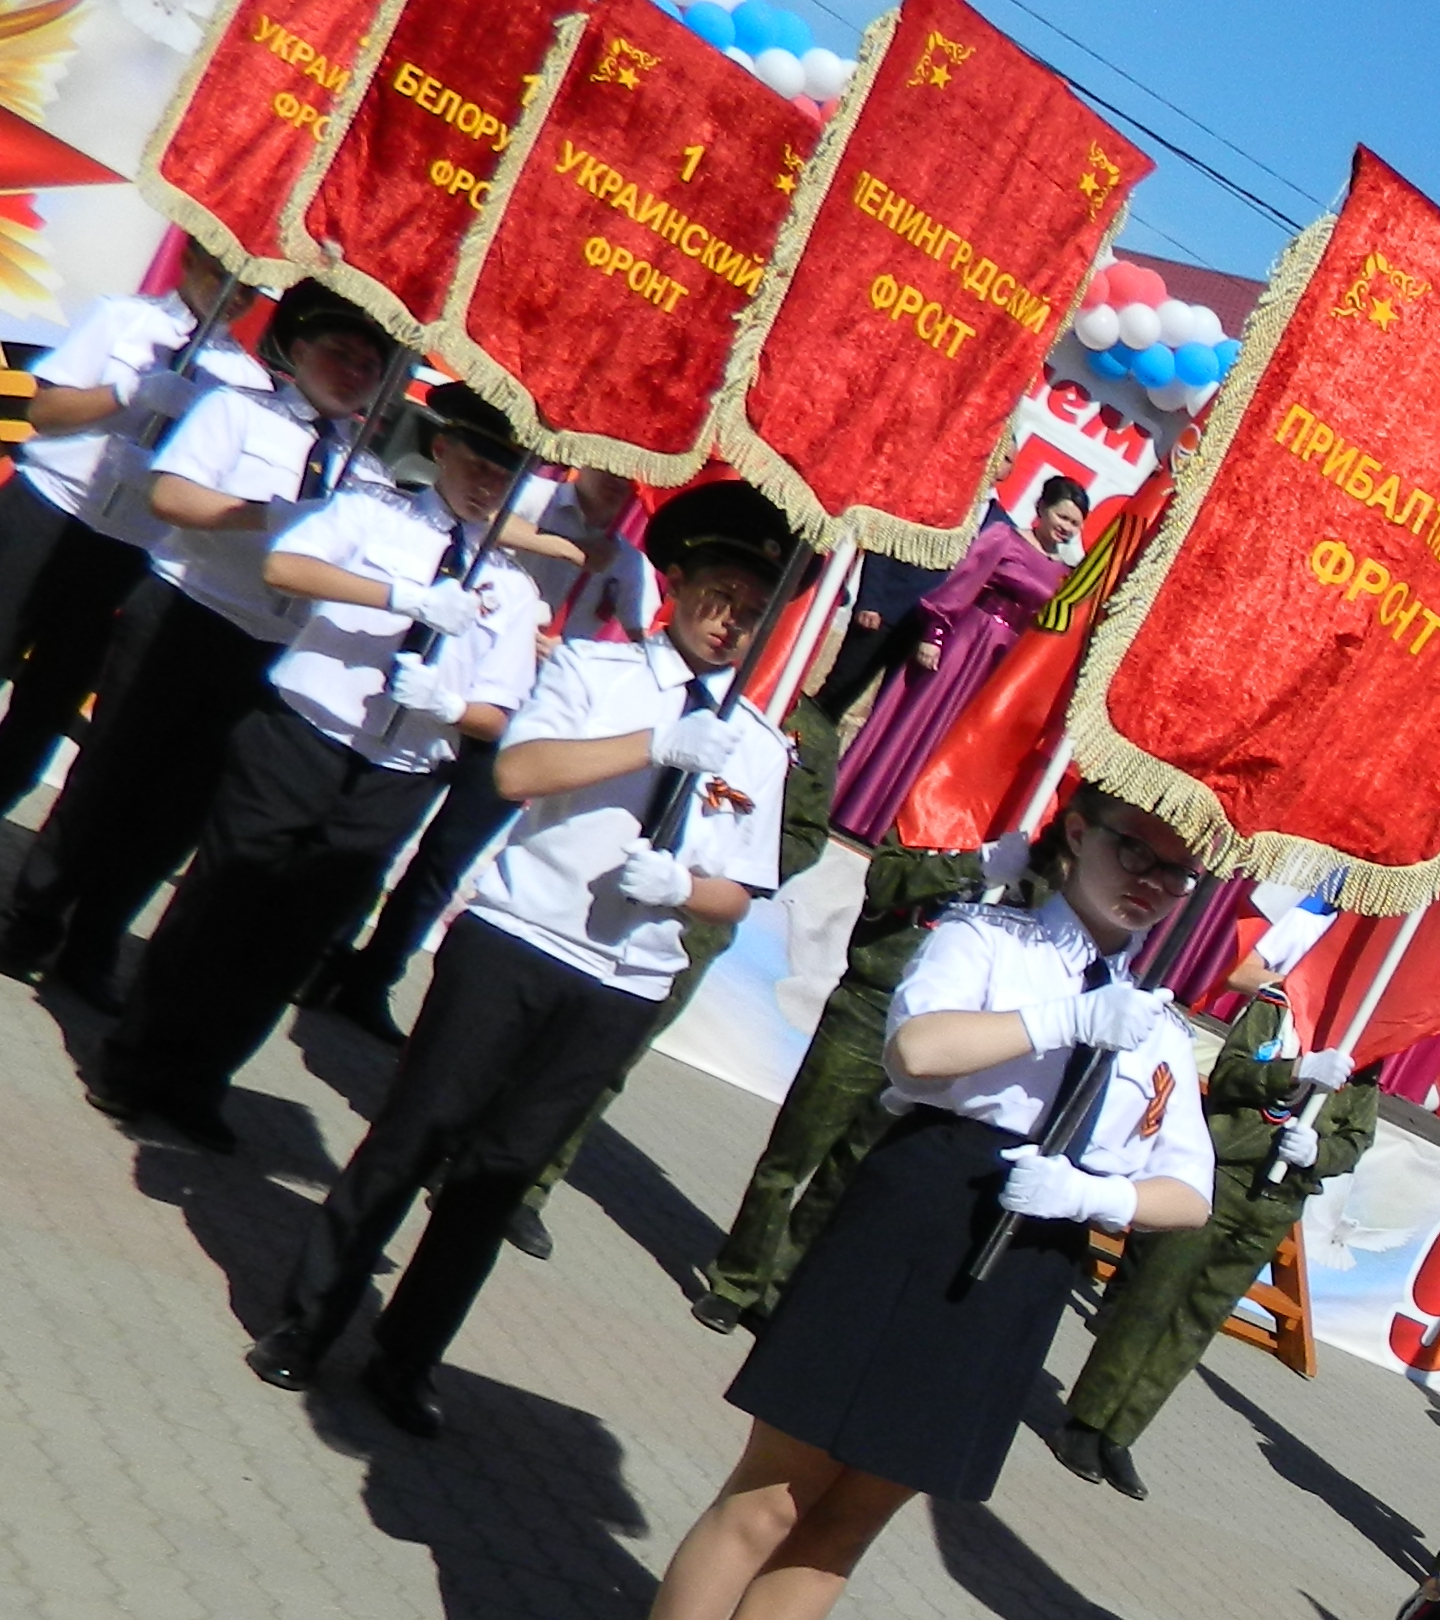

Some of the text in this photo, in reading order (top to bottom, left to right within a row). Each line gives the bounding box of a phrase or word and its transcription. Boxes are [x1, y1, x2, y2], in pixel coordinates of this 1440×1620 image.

[556, 140, 765, 296] УКРАИНСКИЙ
[680, 145, 705, 182] 1
[584, 236, 689, 313] ФРОНТ
[854, 170, 1051, 334] ЛЕНИНГРДСКИЙ
